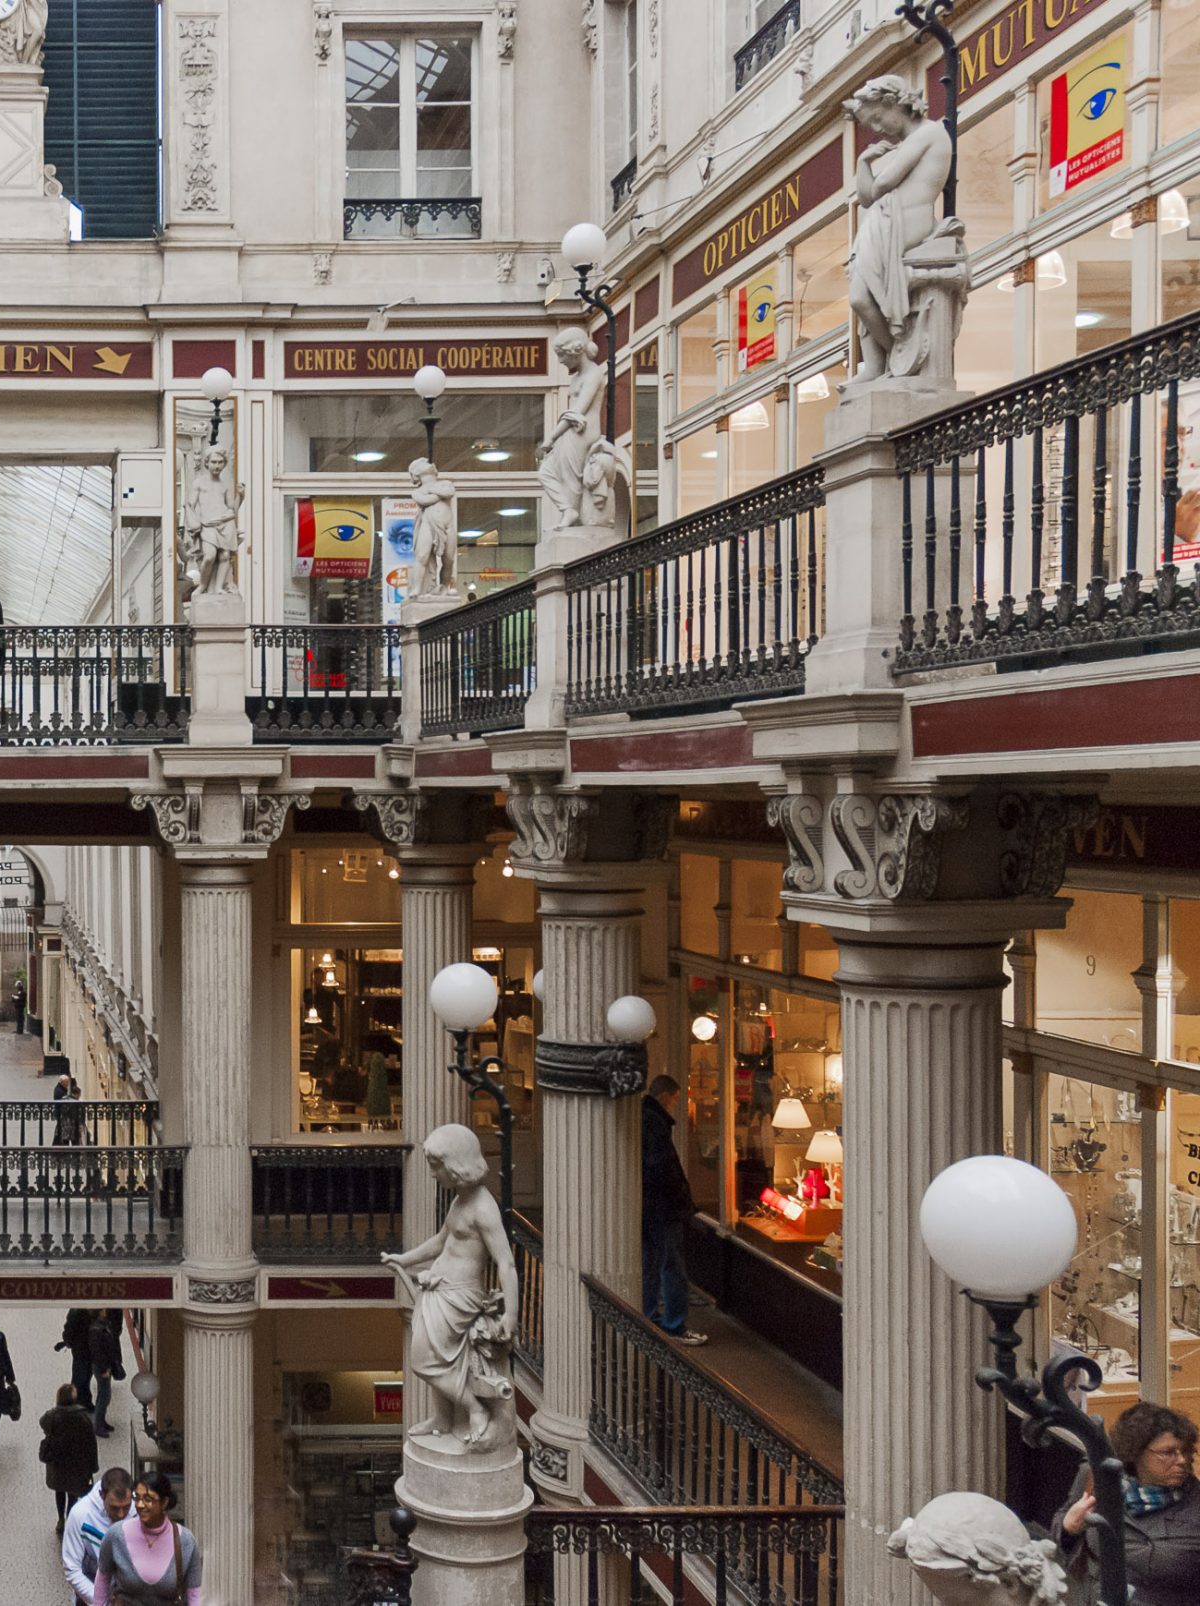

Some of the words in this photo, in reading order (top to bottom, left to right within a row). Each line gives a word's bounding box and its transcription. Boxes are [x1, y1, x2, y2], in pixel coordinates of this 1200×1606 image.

[958, 0, 1093, 95] MUTU
[1068, 148, 1121, 182] MUTUALISTES
[1082, 136, 1121, 164] OPTICIENS
[703, 174, 801, 276] OPTICIEN
[293, 348, 357, 371] CENTRE
[367, 347, 426, 371] SOCIAL
[437, 343, 540, 370] COOPÉRATIF
[1086, 954, 1097, 977] 9
